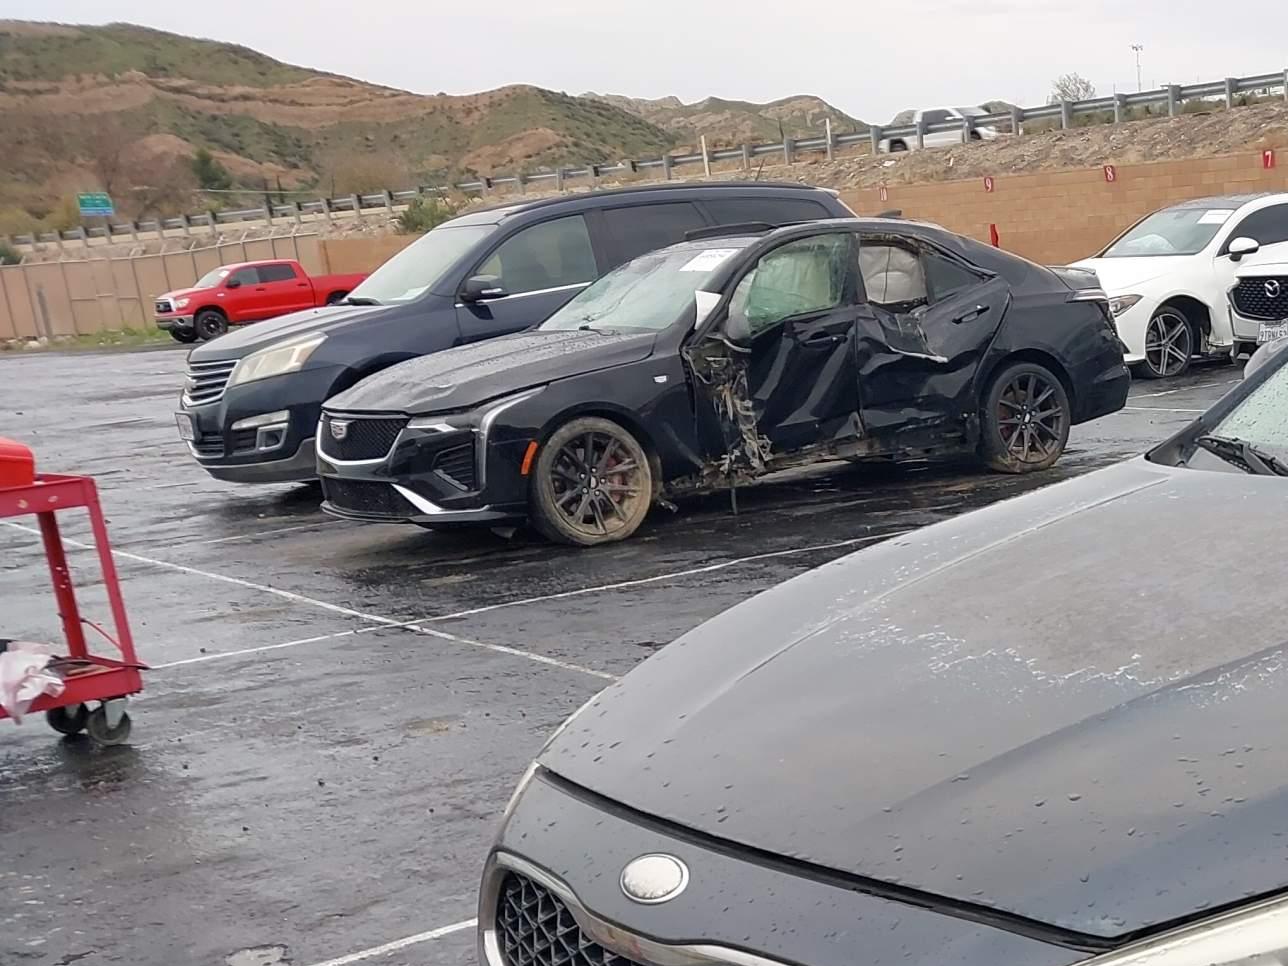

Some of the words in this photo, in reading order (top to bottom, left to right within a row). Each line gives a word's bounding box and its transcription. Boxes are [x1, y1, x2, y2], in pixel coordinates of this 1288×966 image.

[1265, 151, 1273, 168] 7
[1105, 166, 1114, 181] 8
[985, 178, 992, 192] 9
